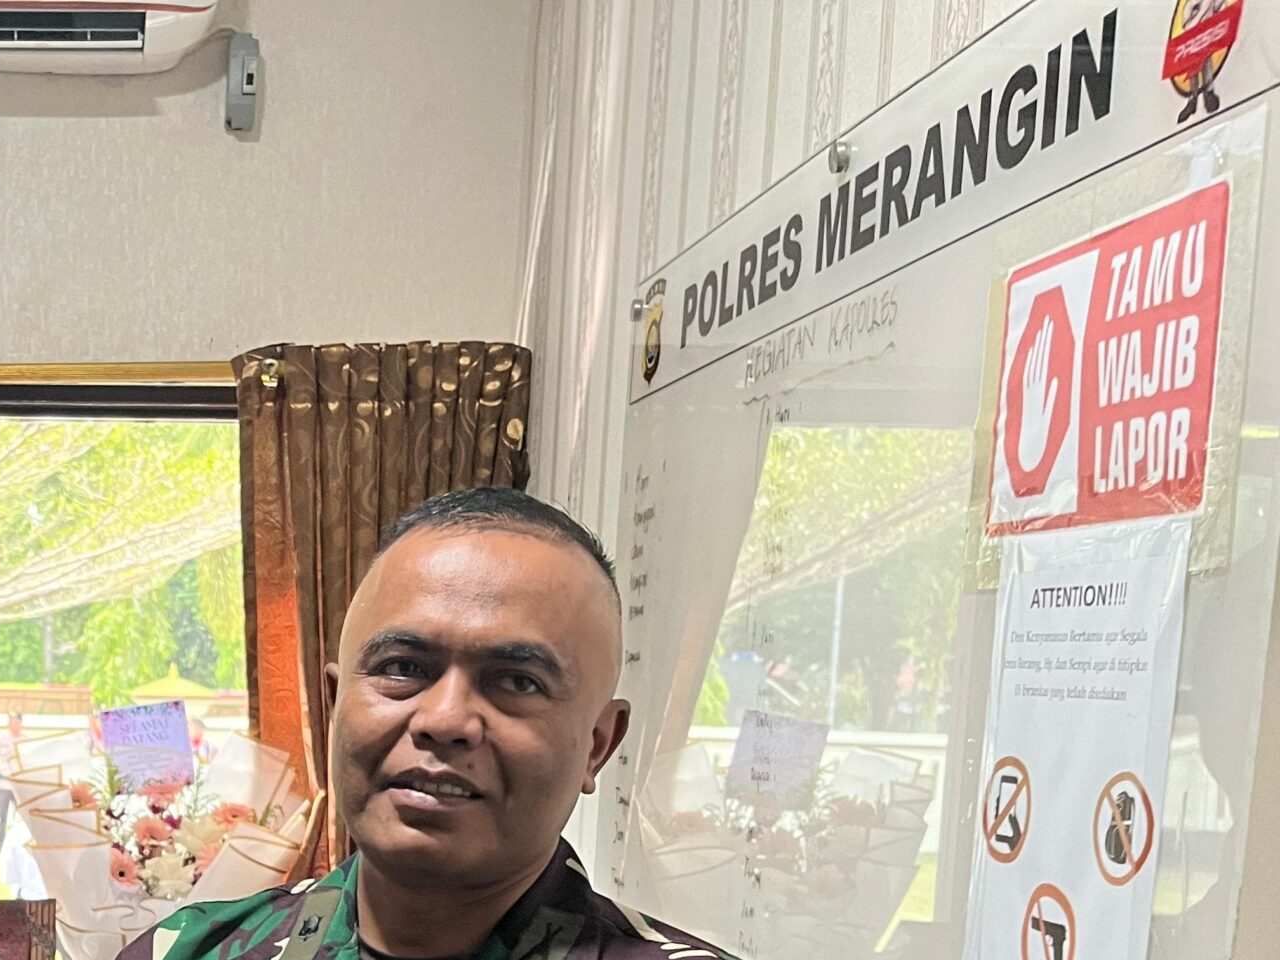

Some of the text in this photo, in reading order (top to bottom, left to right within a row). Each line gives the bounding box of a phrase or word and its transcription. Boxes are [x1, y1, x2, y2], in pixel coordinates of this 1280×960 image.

[680, 8, 1118, 349] POLRES MERANGIN
[1105, 219, 1207, 322] TAMU
[1098, 314, 1200, 408] WAJIB
[1093, 407, 1191, 494] LAPOR
